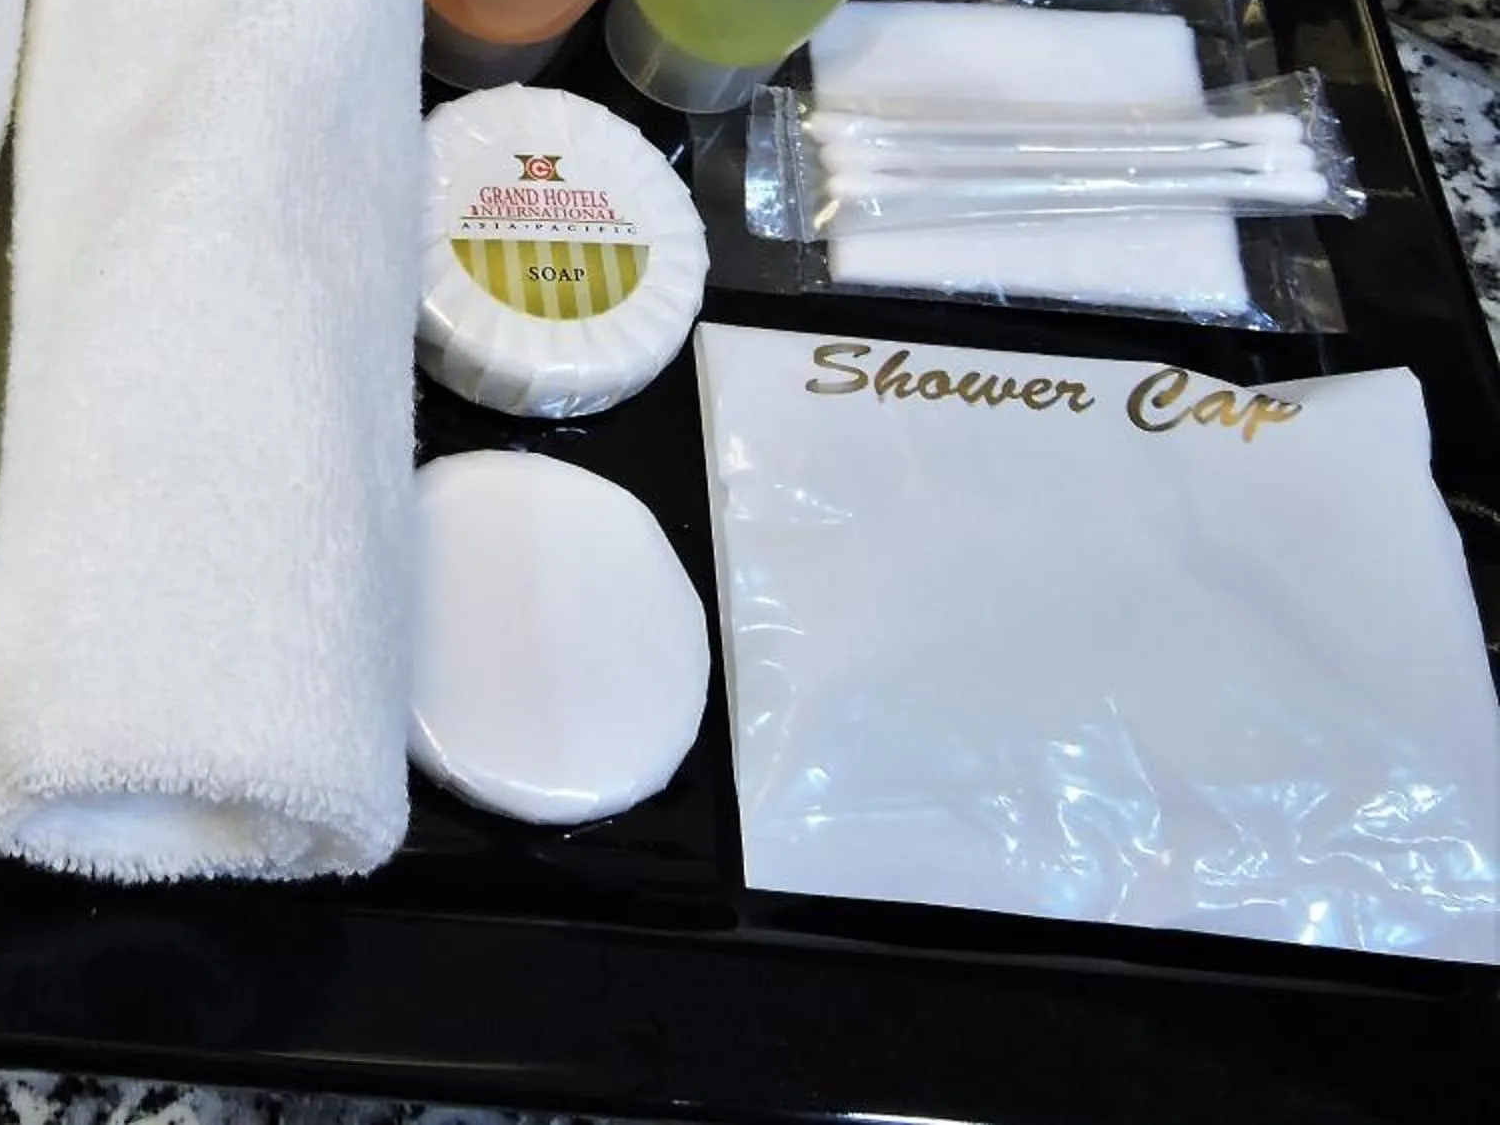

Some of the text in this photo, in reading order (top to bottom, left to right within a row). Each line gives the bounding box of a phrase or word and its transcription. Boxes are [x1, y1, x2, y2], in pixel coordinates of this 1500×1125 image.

[479, 186, 609, 208] GRAND HOTELS
[470, 204, 616, 220] INTERNATIONAL
[528, 266, 586, 282] SOAP
[805, 342, 1303, 442] Shower Cap
